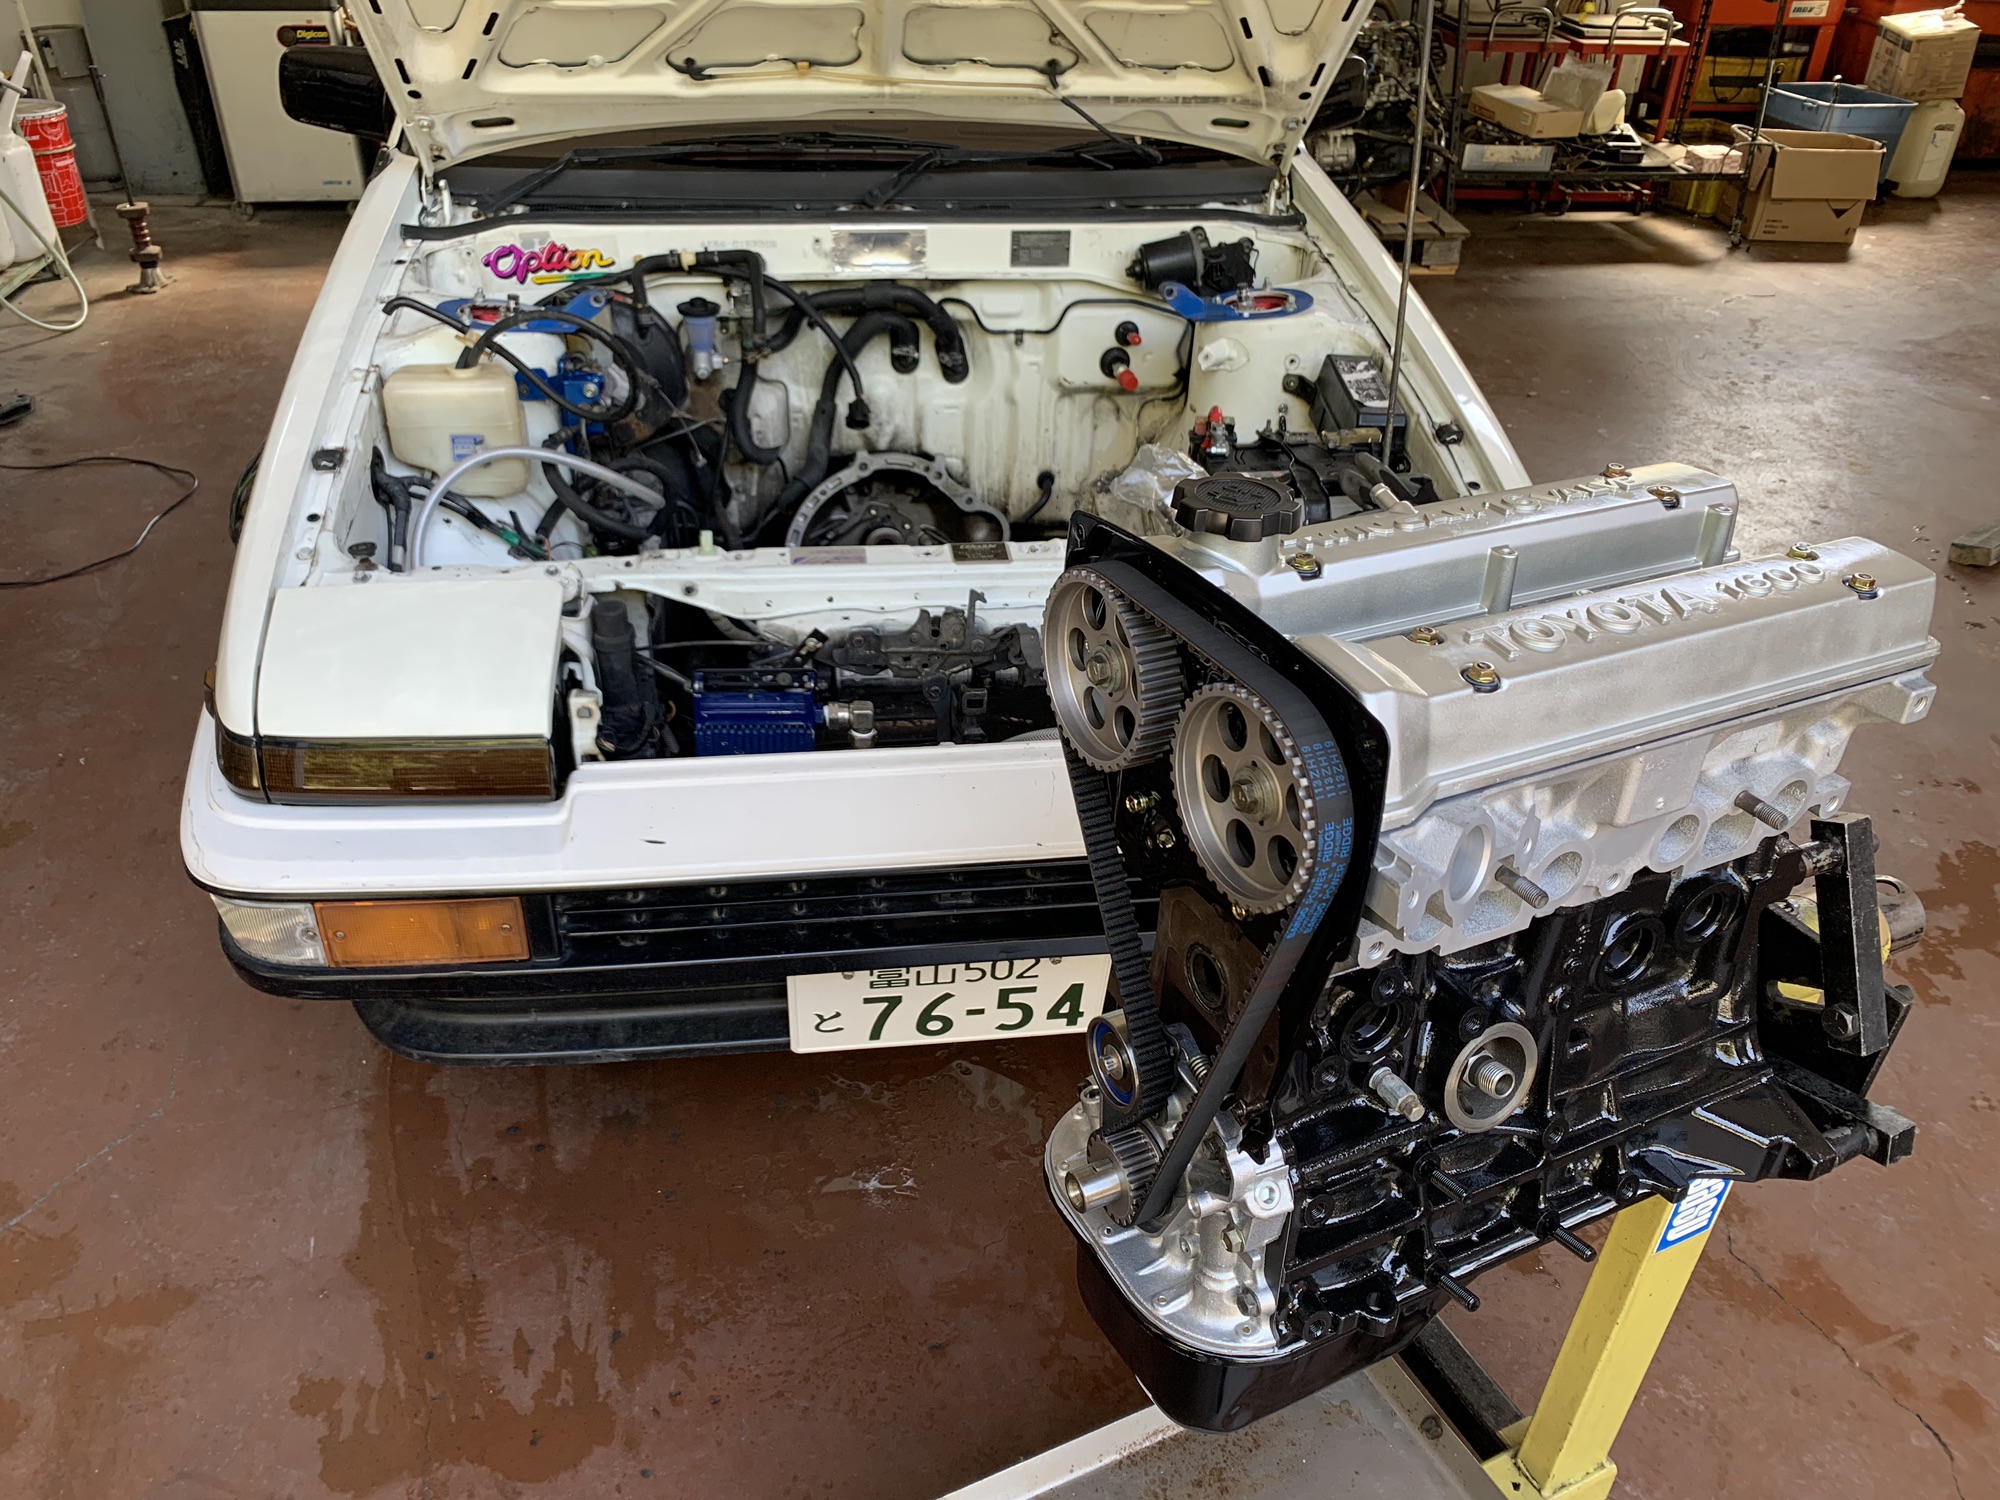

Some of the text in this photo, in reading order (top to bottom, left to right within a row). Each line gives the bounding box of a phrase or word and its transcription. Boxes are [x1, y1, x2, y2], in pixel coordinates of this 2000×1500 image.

[481, 240, 615, 284] Option
[1463, 562, 1825, 661] TOYOTA 1600
[1302, 745, 1325, 801] 113ZH19
[1312, 742, 1336, 799] 113ZH19
[1323, 740, 1348, 796] 113ZH19
[1322, 821, 1335, 863] RIDGE
[1340, 816, 1353, 859] RIDGE
[813, 983, 1085, 1041] と 76-54
